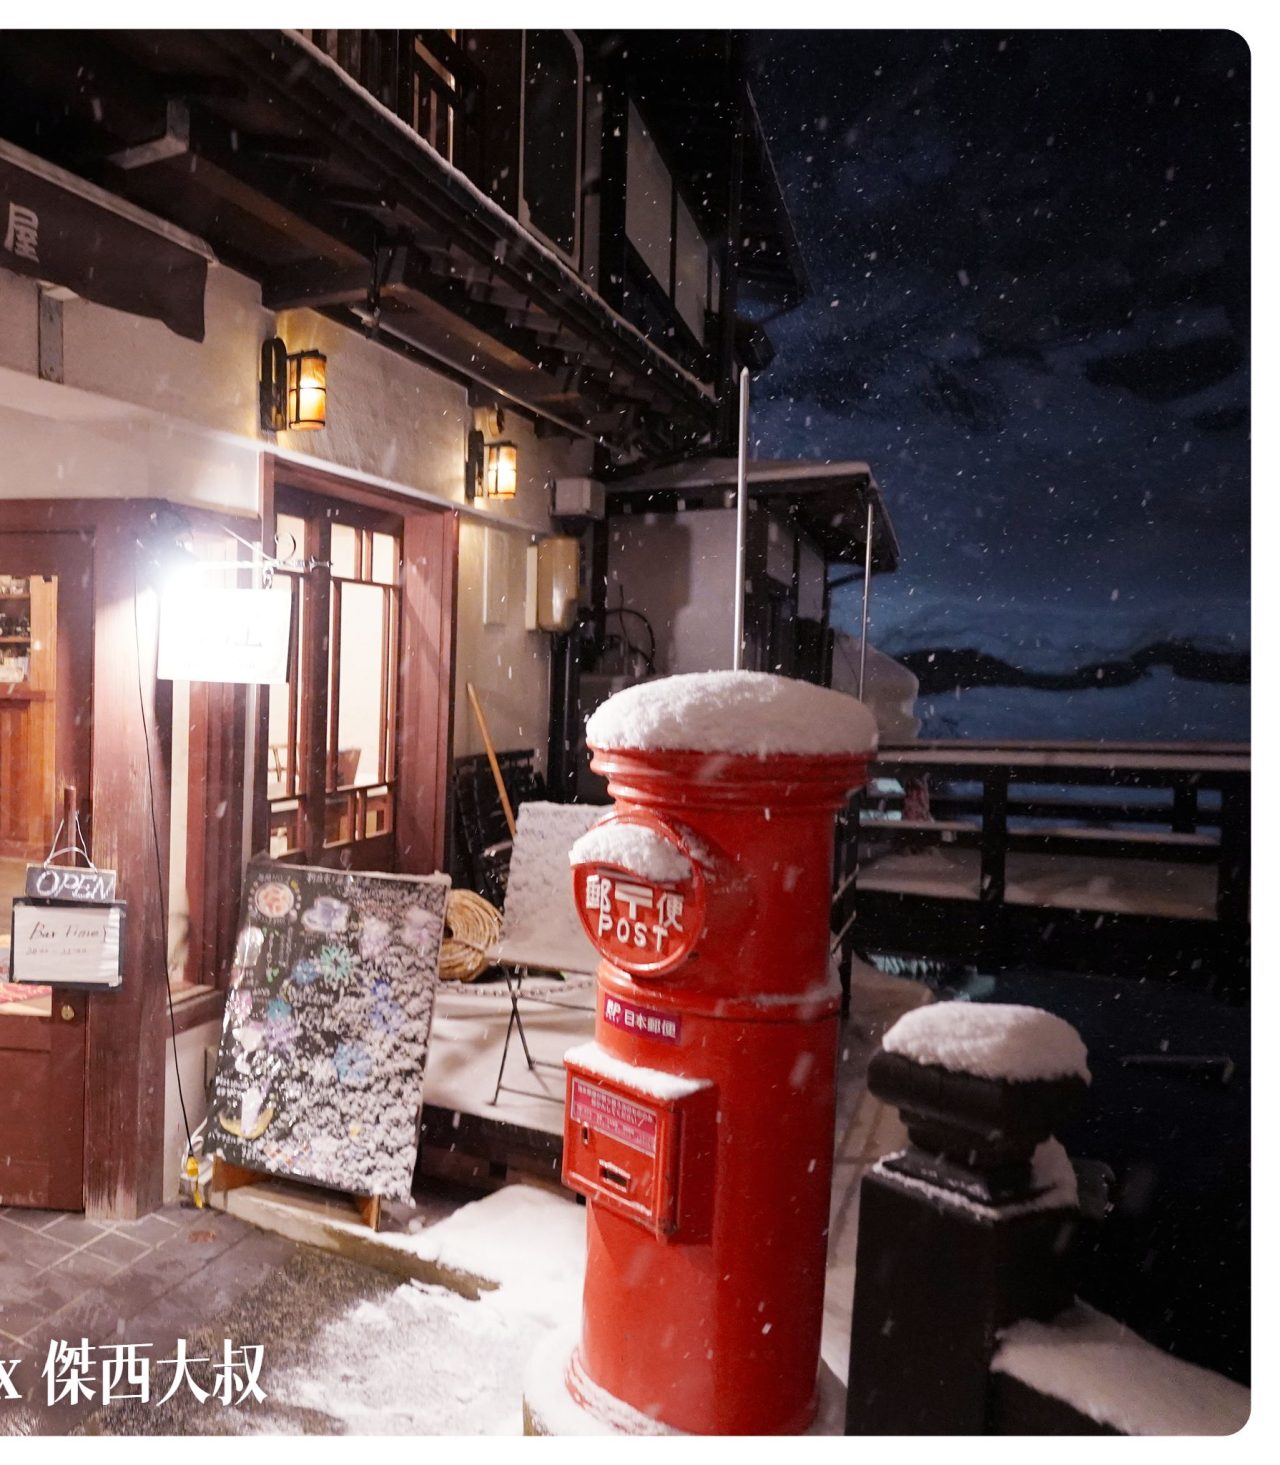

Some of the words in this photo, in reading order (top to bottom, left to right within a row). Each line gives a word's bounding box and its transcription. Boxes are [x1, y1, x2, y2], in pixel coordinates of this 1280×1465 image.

[36, 869, 114, 900] OPEN
[598, 911, 669, 952] POST
[624, 1008, 677, 1039] 日本郵便
